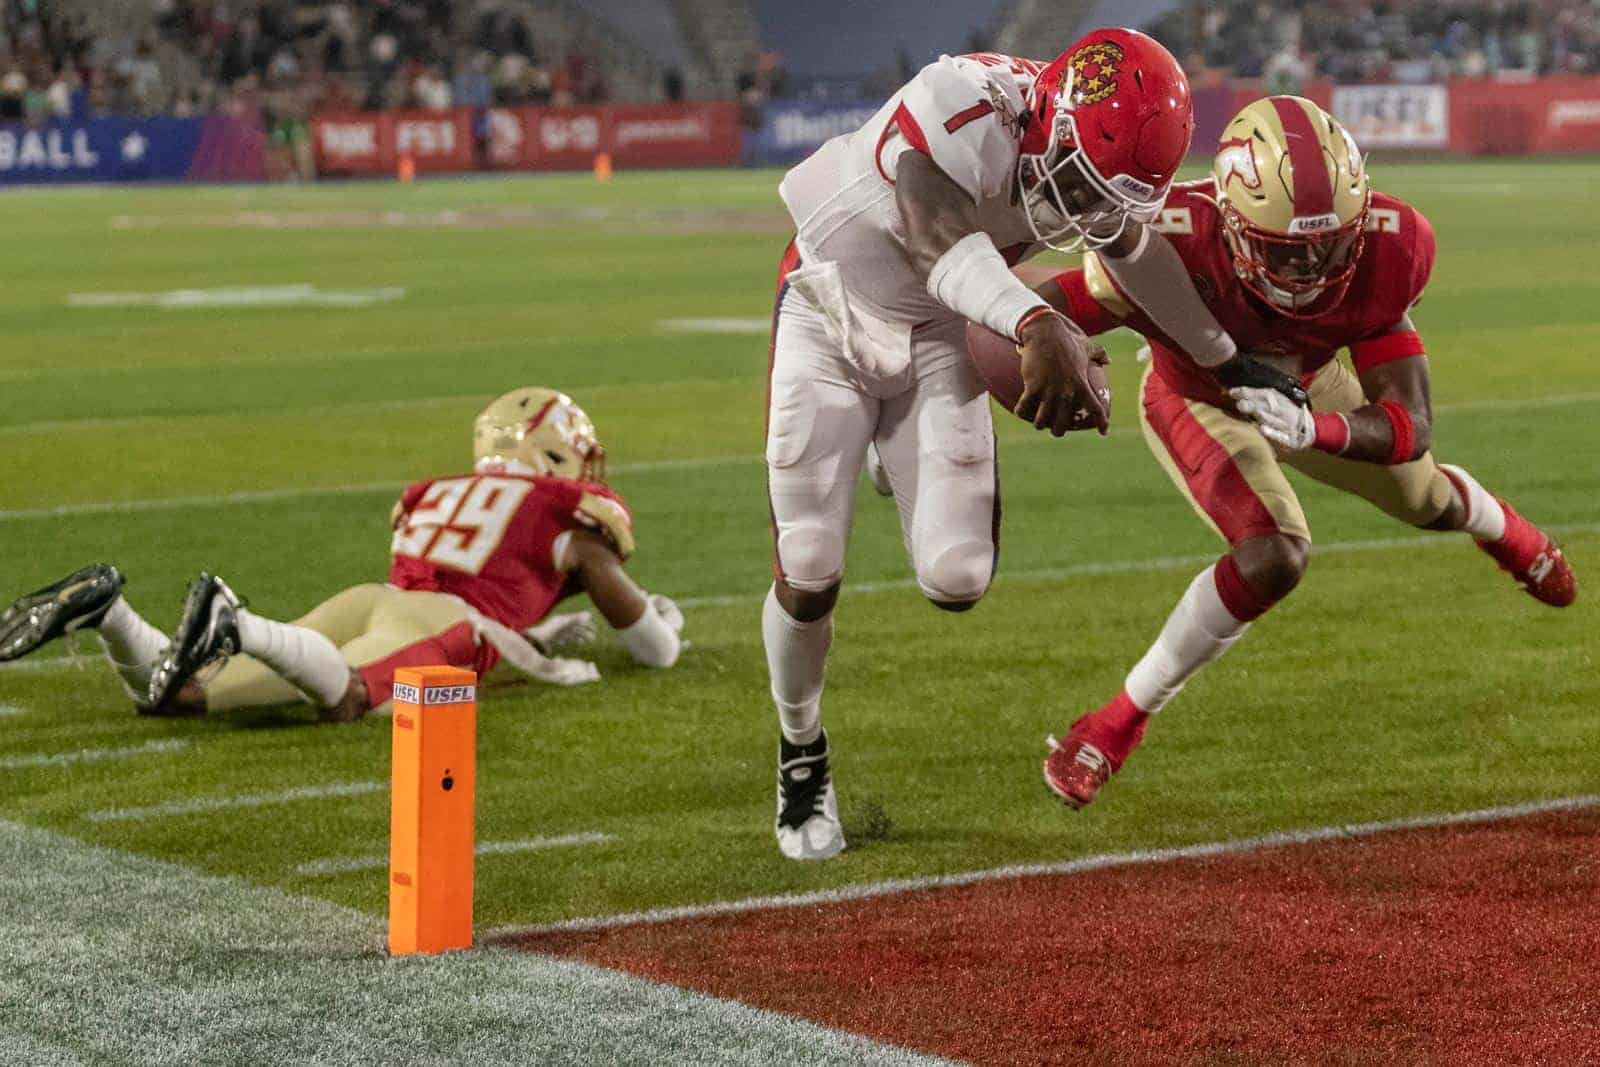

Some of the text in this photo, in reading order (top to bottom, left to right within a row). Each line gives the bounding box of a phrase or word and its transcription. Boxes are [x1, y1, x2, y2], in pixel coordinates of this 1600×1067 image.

[943, 99, 994, 134] 1
[1298, 218, 1333, 231] USFL
[391, 477, 535, 574] 29
[395, 684, 417, 702] USFL
[427, 687, 473, 703] USFL
